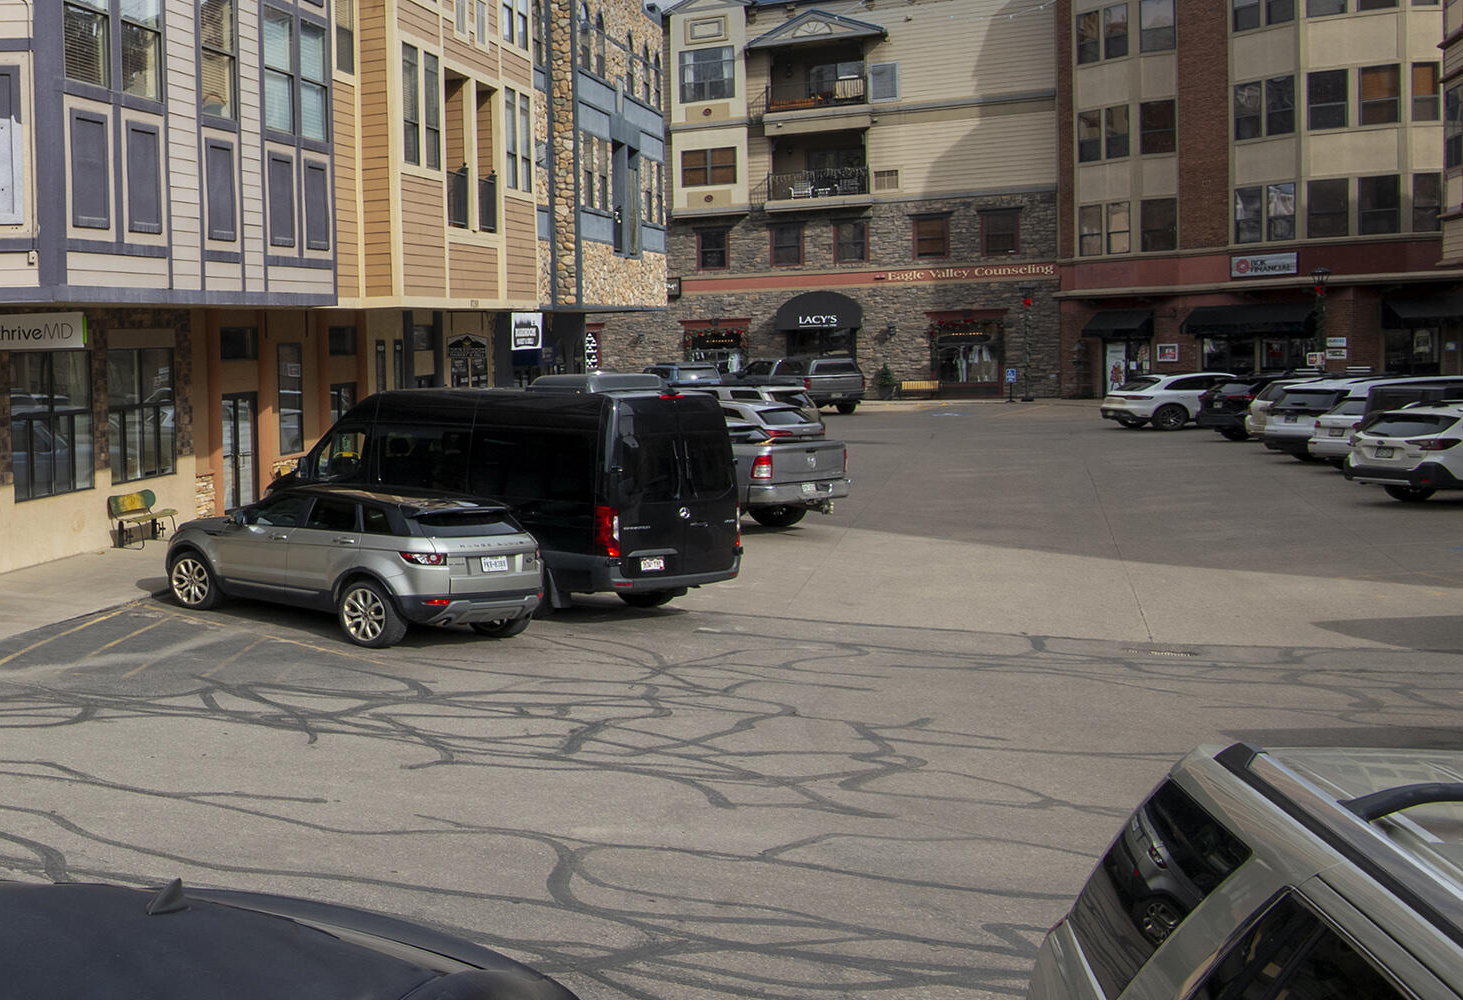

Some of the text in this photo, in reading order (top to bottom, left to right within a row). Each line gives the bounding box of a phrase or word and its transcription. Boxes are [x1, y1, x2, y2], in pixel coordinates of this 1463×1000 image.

[887, 264, 1054, 281] Eagle Valley Counseling
[1250, 264, 1291, 273] FINANCIAL
[798, 315, 838, 325] LACY'S
